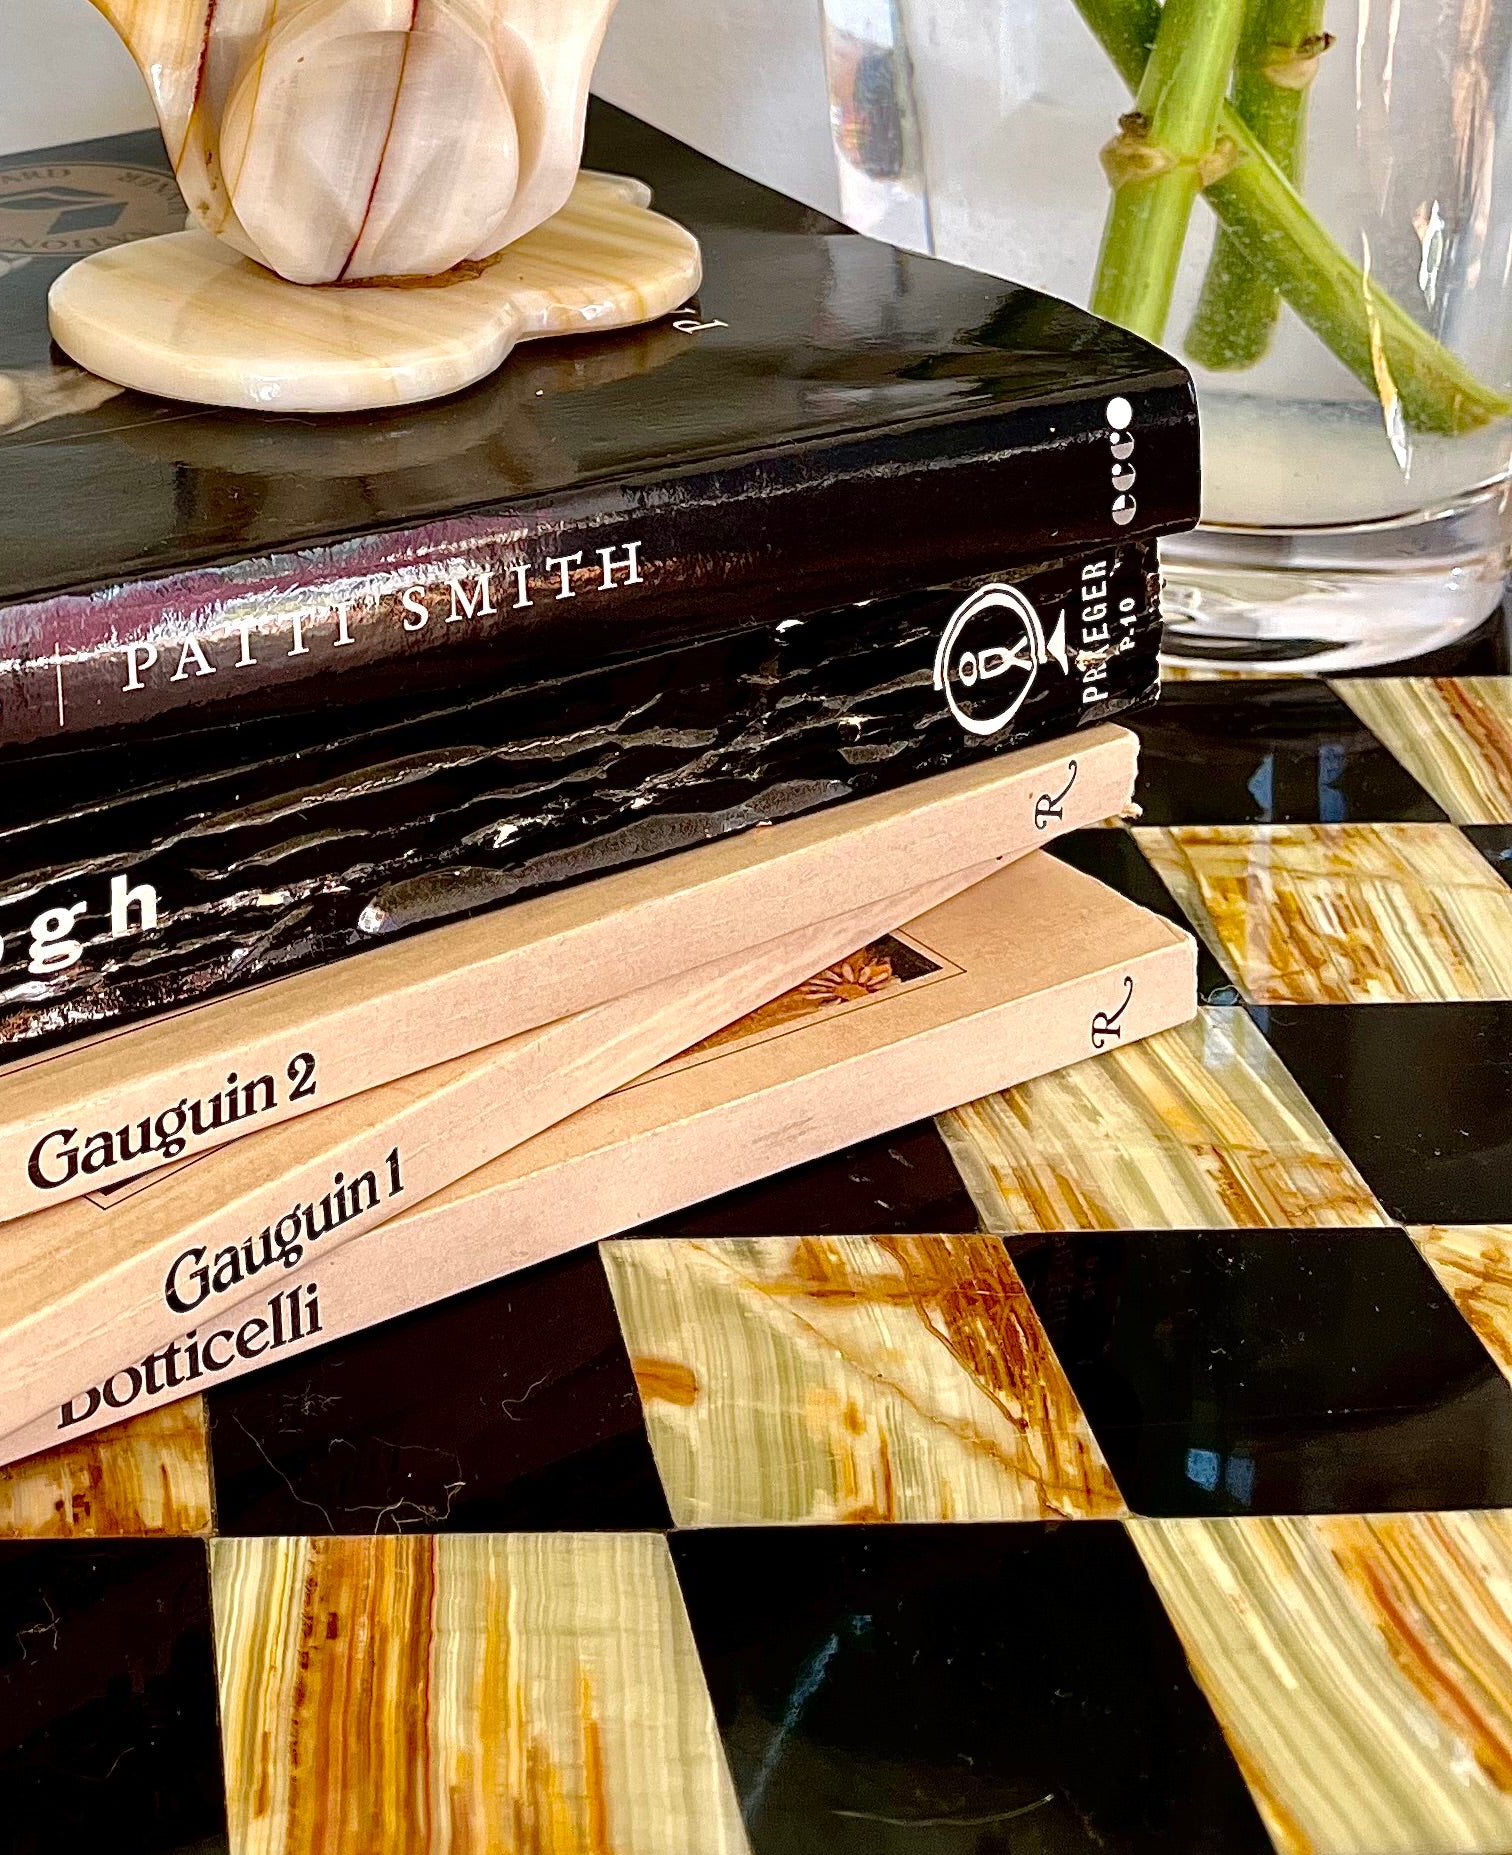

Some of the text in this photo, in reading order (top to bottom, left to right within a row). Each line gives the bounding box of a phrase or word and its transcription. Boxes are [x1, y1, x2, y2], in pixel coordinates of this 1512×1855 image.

[1106, 396, 1137, 526] ecco
[120, 541, 645, 693] PATTI SMITH
[1082, 559, 1110, 704] PRAEGER
[1119, 597, 1137, 651] P-10
[27, 1052, 318, 1190] Gauguin 2
[164, 1146, 405, 1314] Gauguin 1
